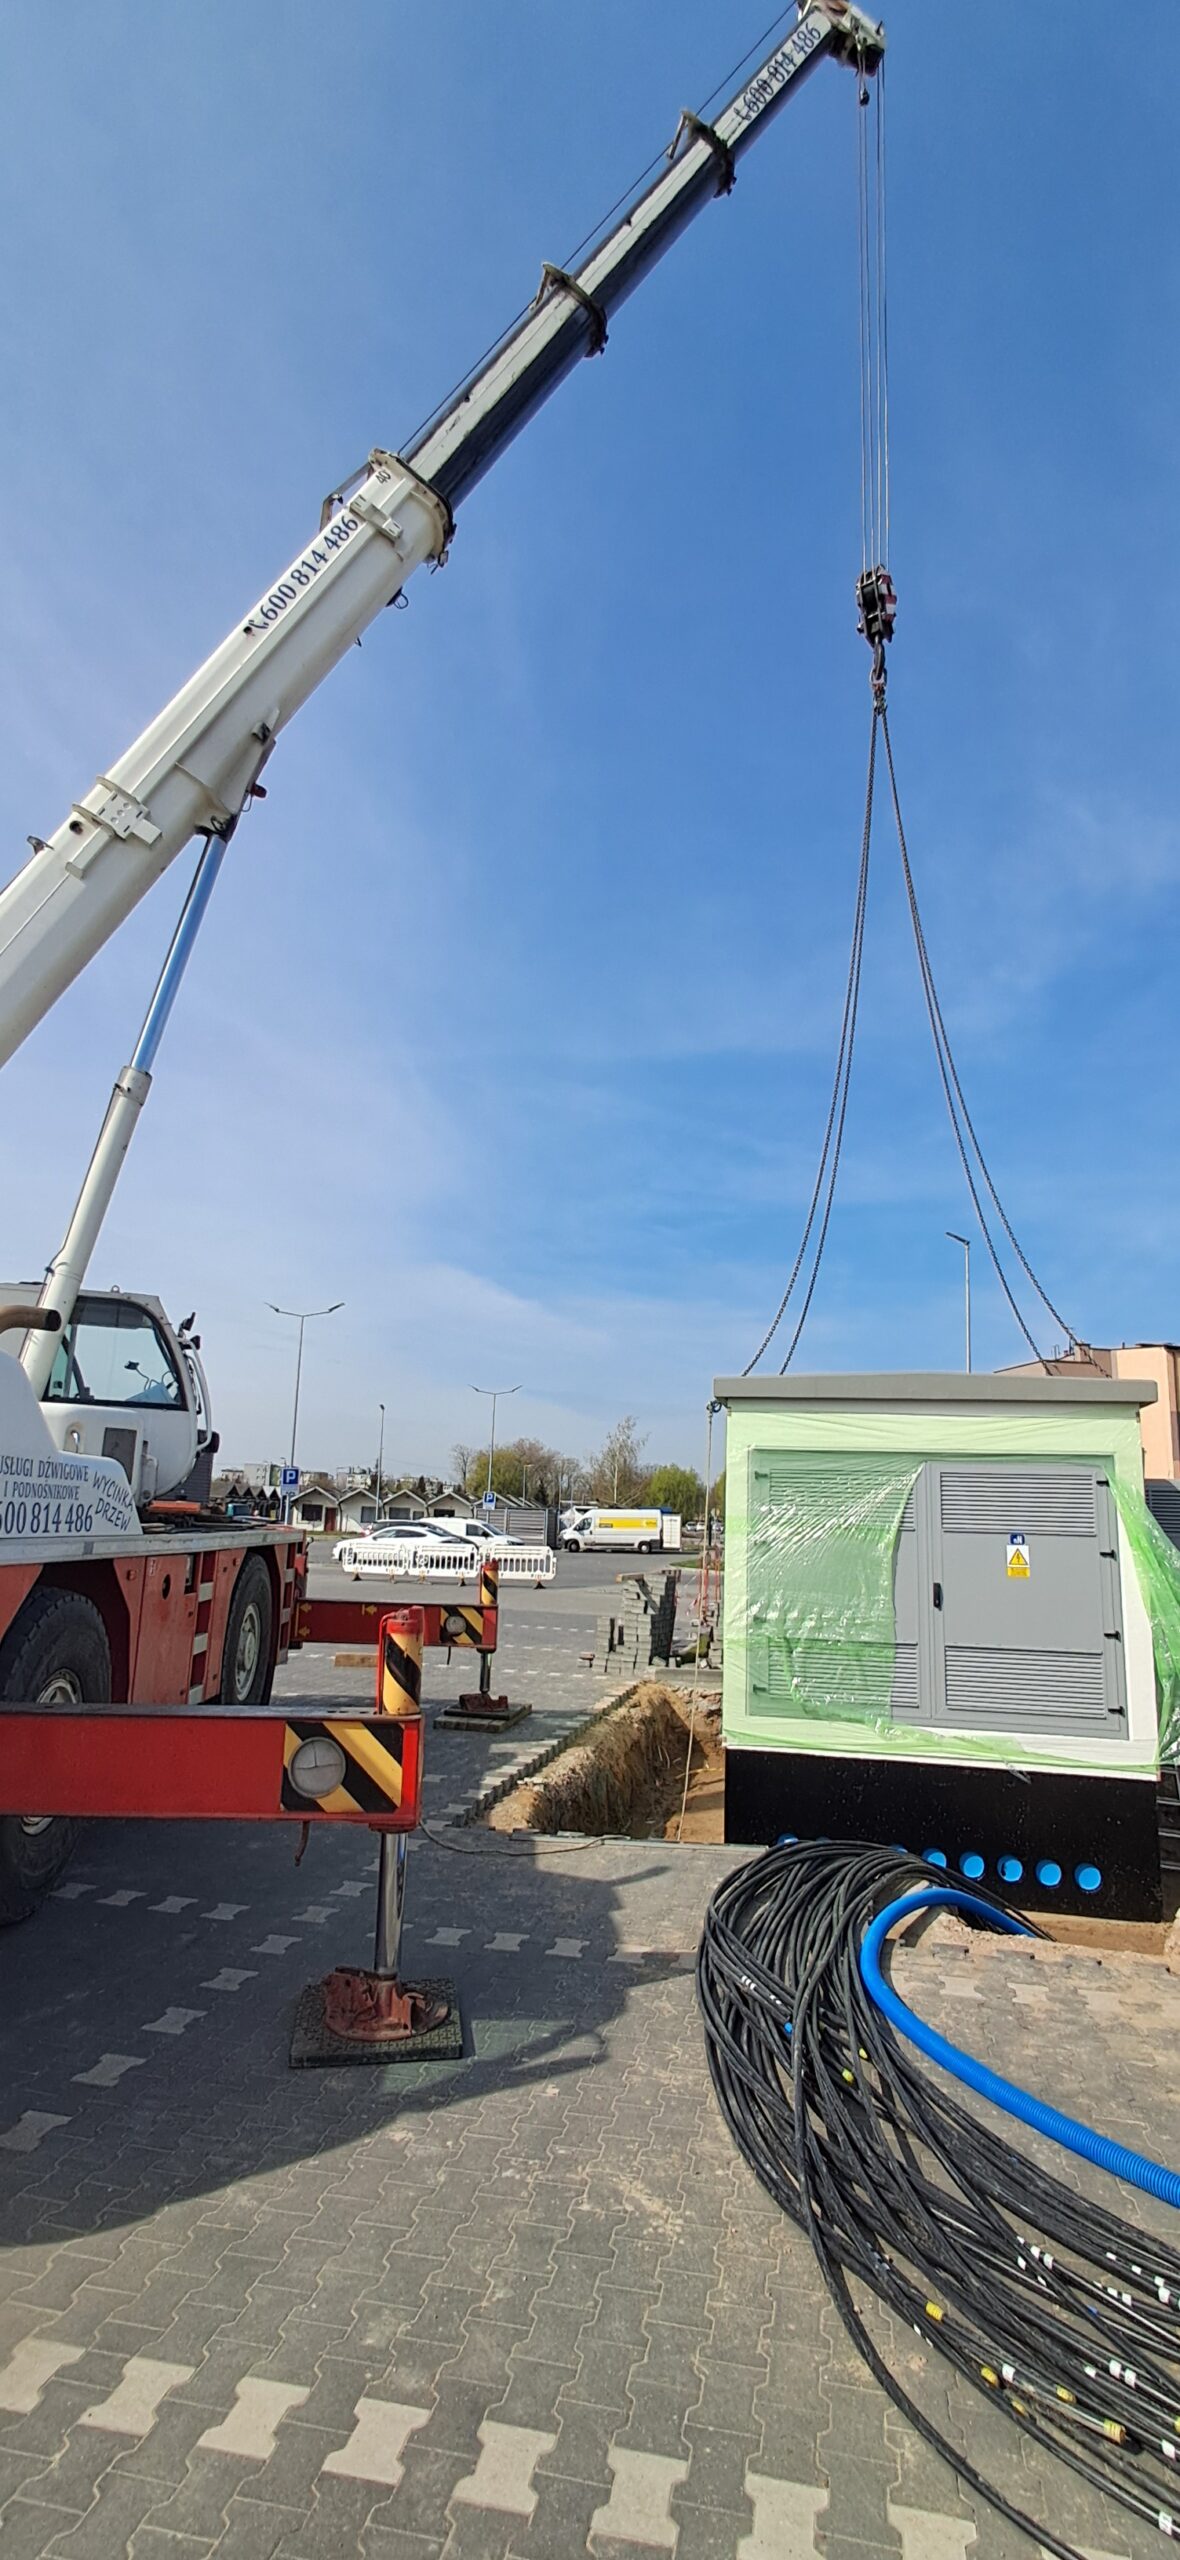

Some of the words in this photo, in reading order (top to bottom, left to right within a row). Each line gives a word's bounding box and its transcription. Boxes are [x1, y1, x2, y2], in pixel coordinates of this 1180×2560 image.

[742, 78, 774, 114] 600
[767, 52, 797, 84] 814
[791, 22, 821, 56] 486
[375, 470, 391, 484] 40
[260, 583, 297, 621] 600
[291, 549, 329, 587] 814
[323, 515, 358, 550] 486
[38, 1456, 89, 1482] DŹWIGOWE
[286, 1470, 296, 1483] P
[4, 1481, 8, 1497] I
[12, 1480, 80, 1500] PODNOŚNIKOWE
[93, 1470, 133, 1511] WYCINKA
[31, 1502, 62, 1534] 814
[65, 1503, 93, 1532] 486
[95, 1497, 131, 1531] DRZEW
